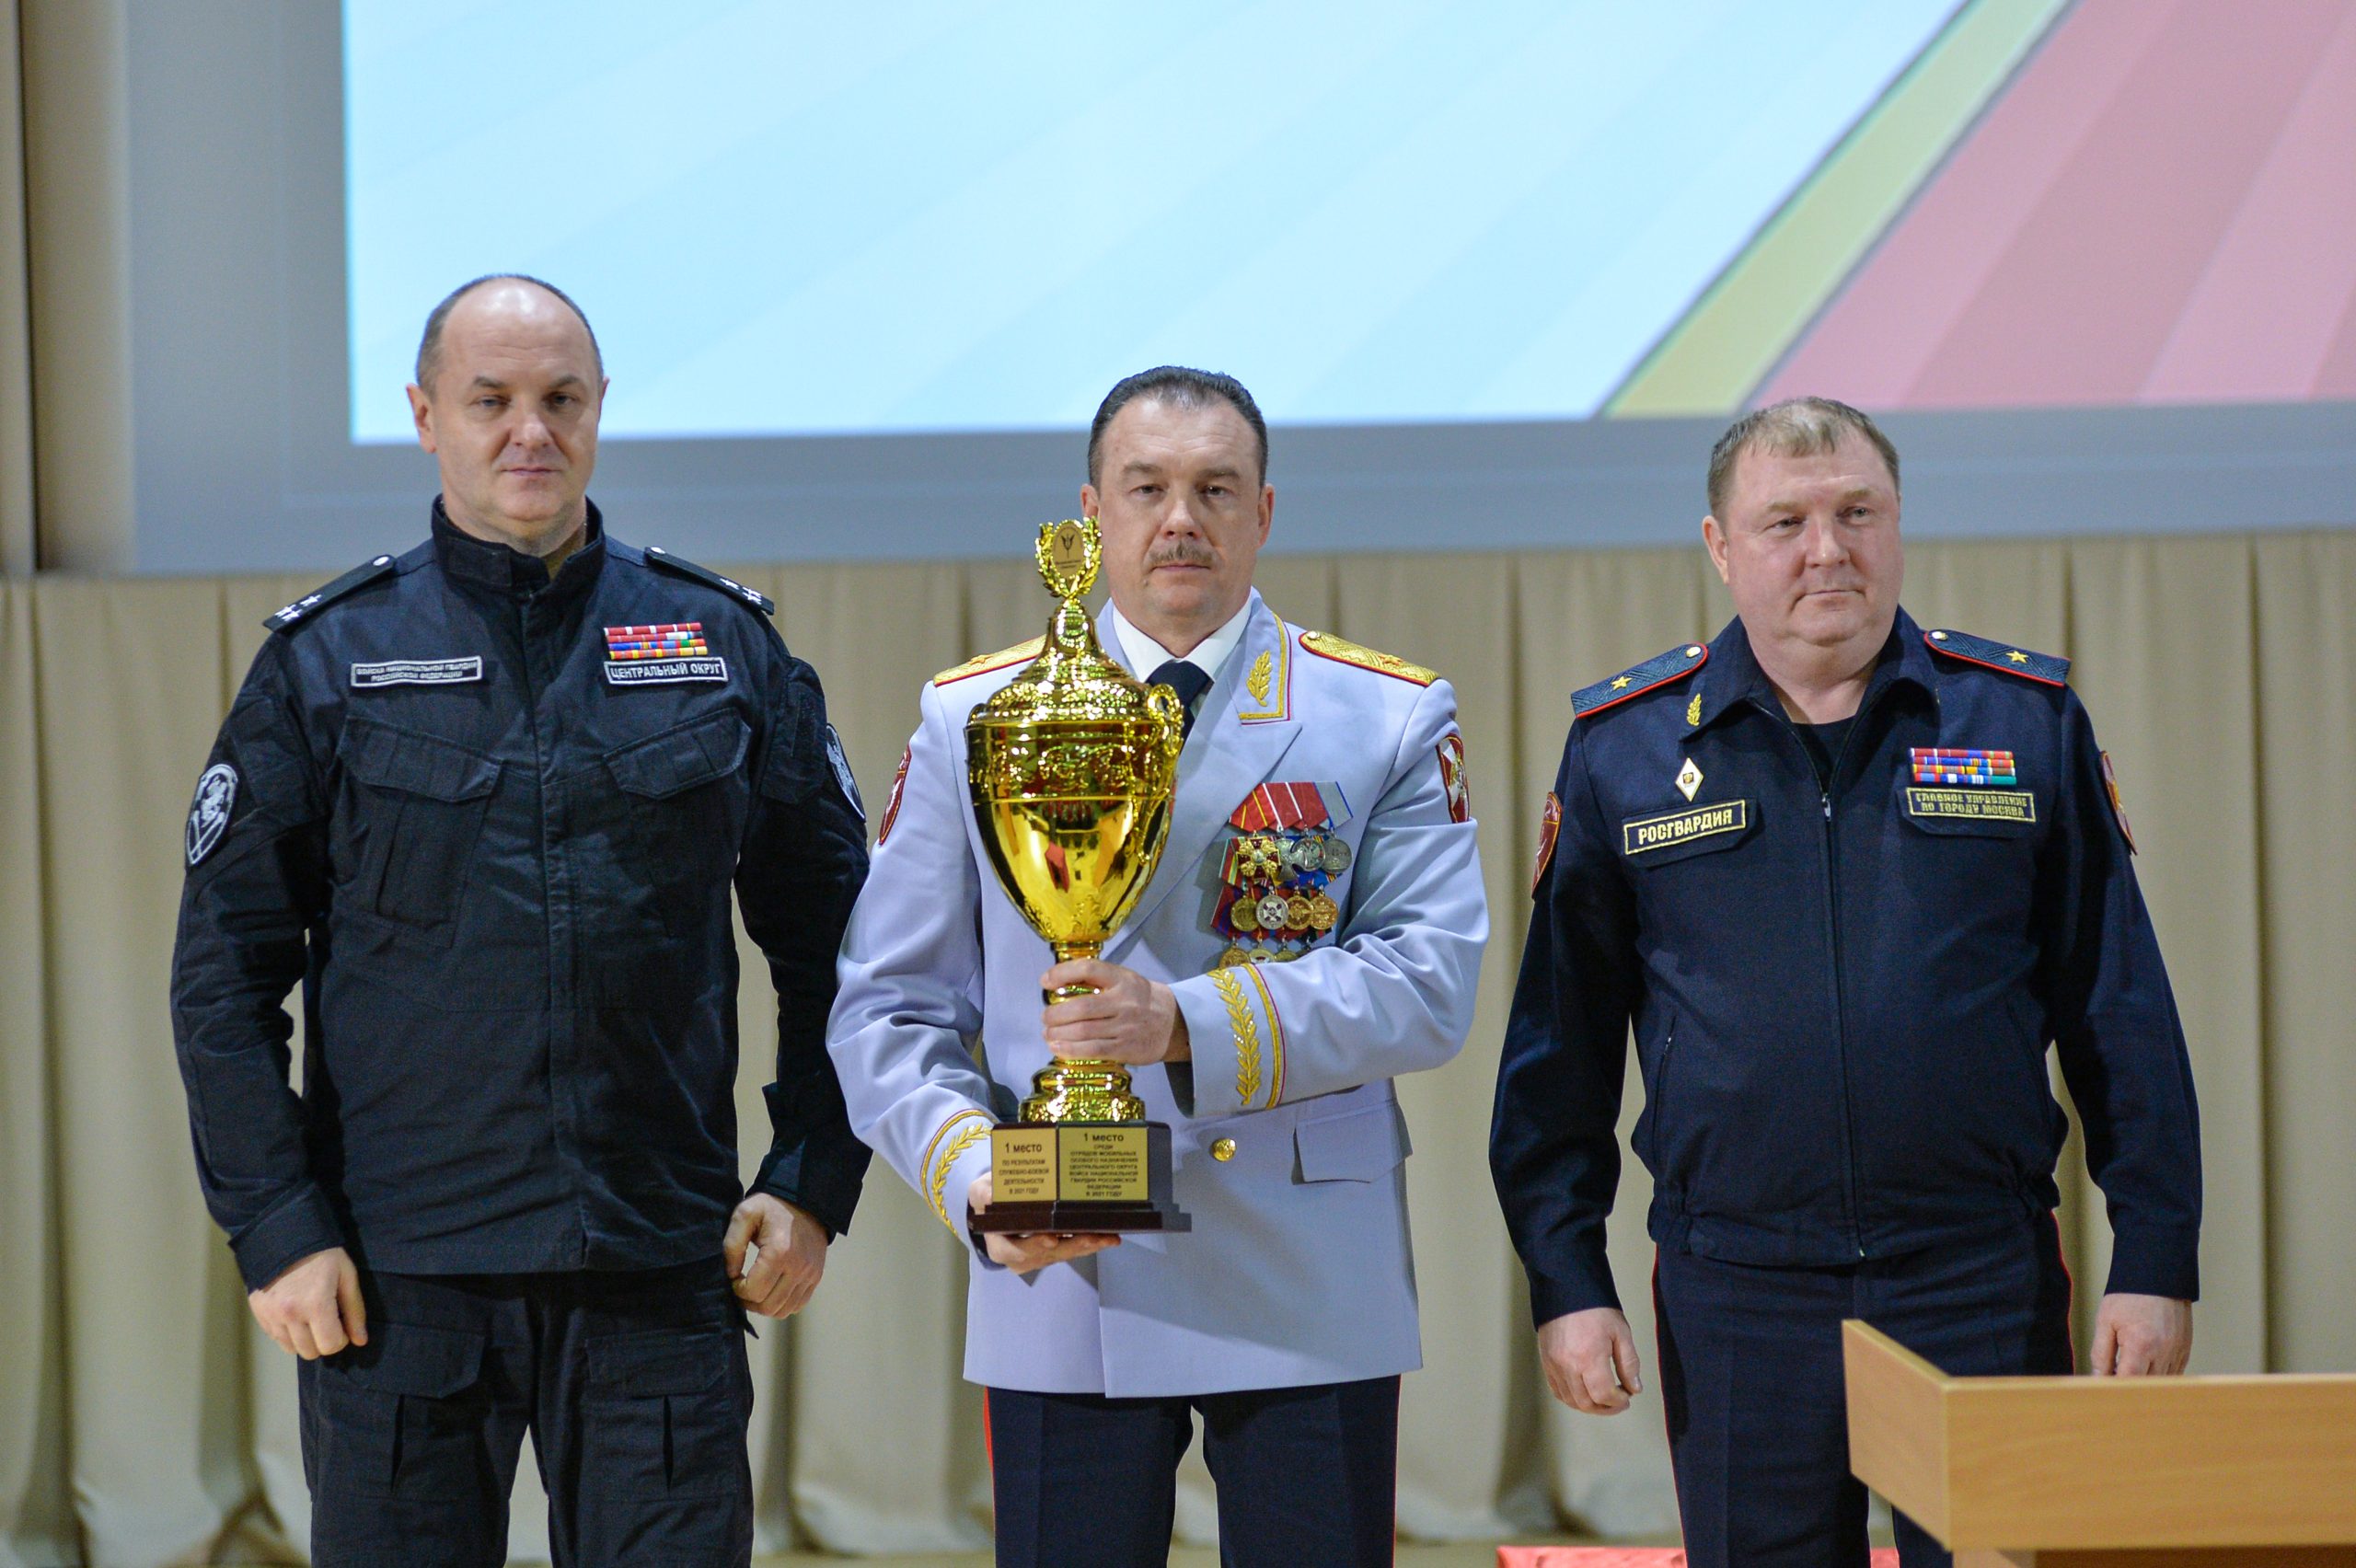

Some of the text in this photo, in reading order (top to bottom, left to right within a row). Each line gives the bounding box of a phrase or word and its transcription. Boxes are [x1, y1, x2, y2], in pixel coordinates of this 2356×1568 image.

[610, 663, 721, 679] ЦЕНТРАЛЬНЫЙ ОКРУГ
[1915, 792, 2027, 807] ГЛАВНОЕ УПРАВЛЕНИЕ
[1921, 802, 1934, 812] ПО
[1939, 802, 1980, 814] ГОРОДУ
[1638, 809, 1733, 845] РОСГВАРДИЯ
[1084, 1133, 1089, 1142] 1
[1005, 1142, 1043, 1153] 1 место
